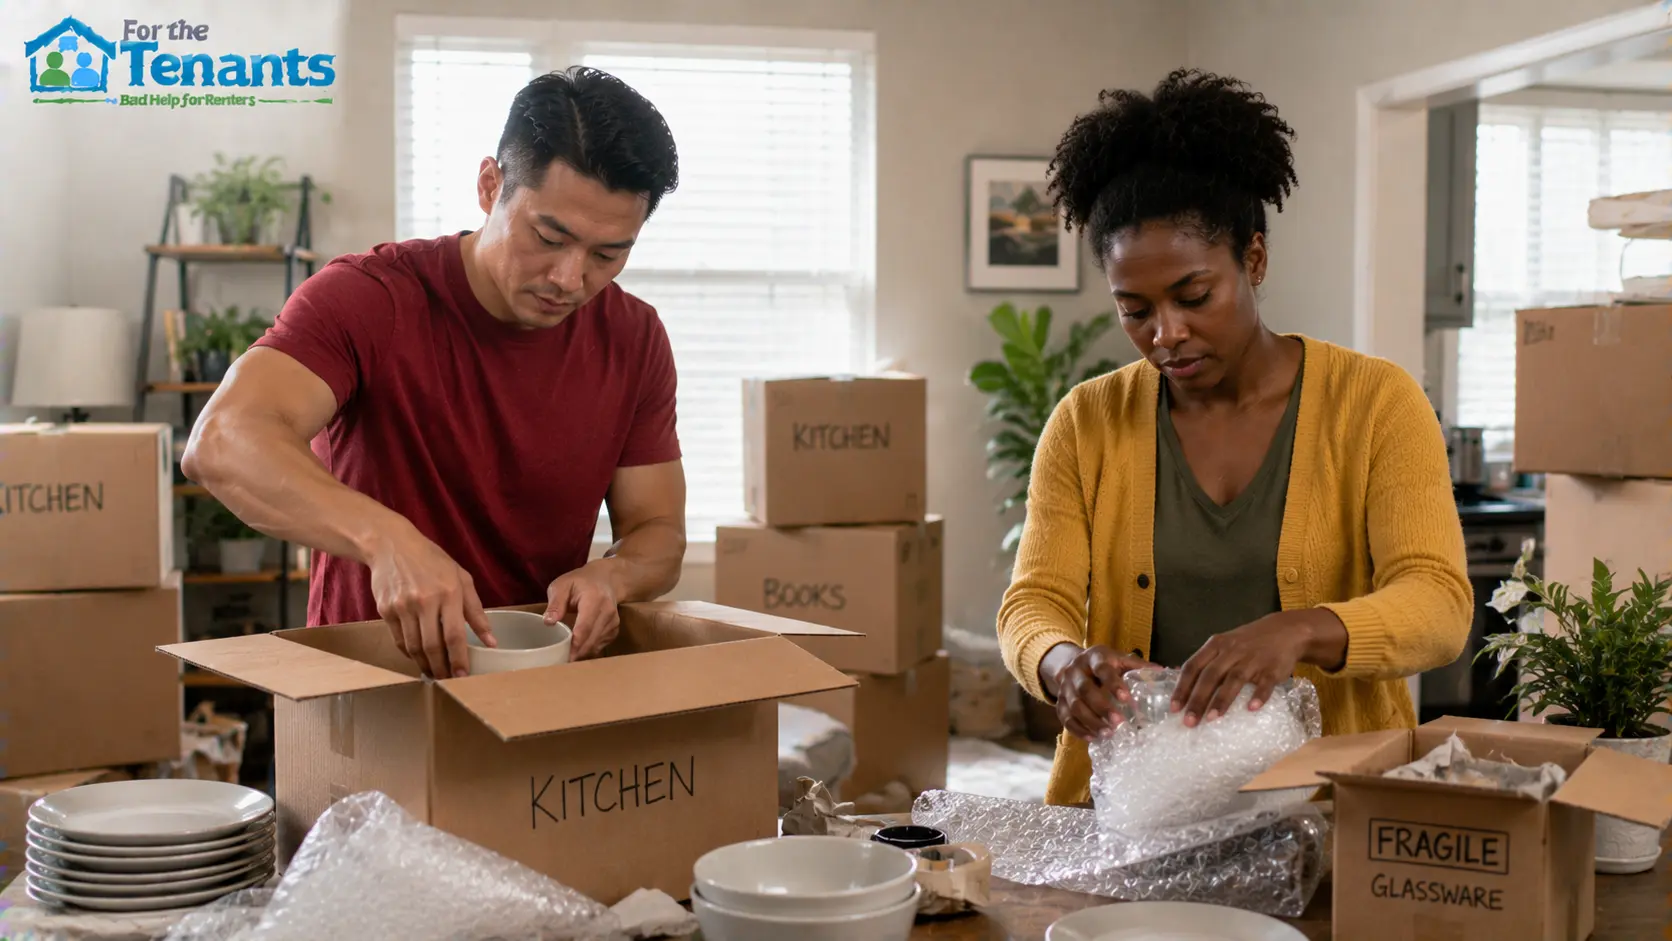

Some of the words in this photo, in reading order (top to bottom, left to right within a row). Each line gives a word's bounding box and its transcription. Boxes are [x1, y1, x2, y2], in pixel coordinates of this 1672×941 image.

[792, 422, 891, 451] KITCHEN
[0, 481, 104, 514] ITCHEN
[530, 755, 695, 829] KITCHEN
[1377, 826, 1499, 866] FRAGILE
[1371, 873, 1504, 911] GLASSWARE
